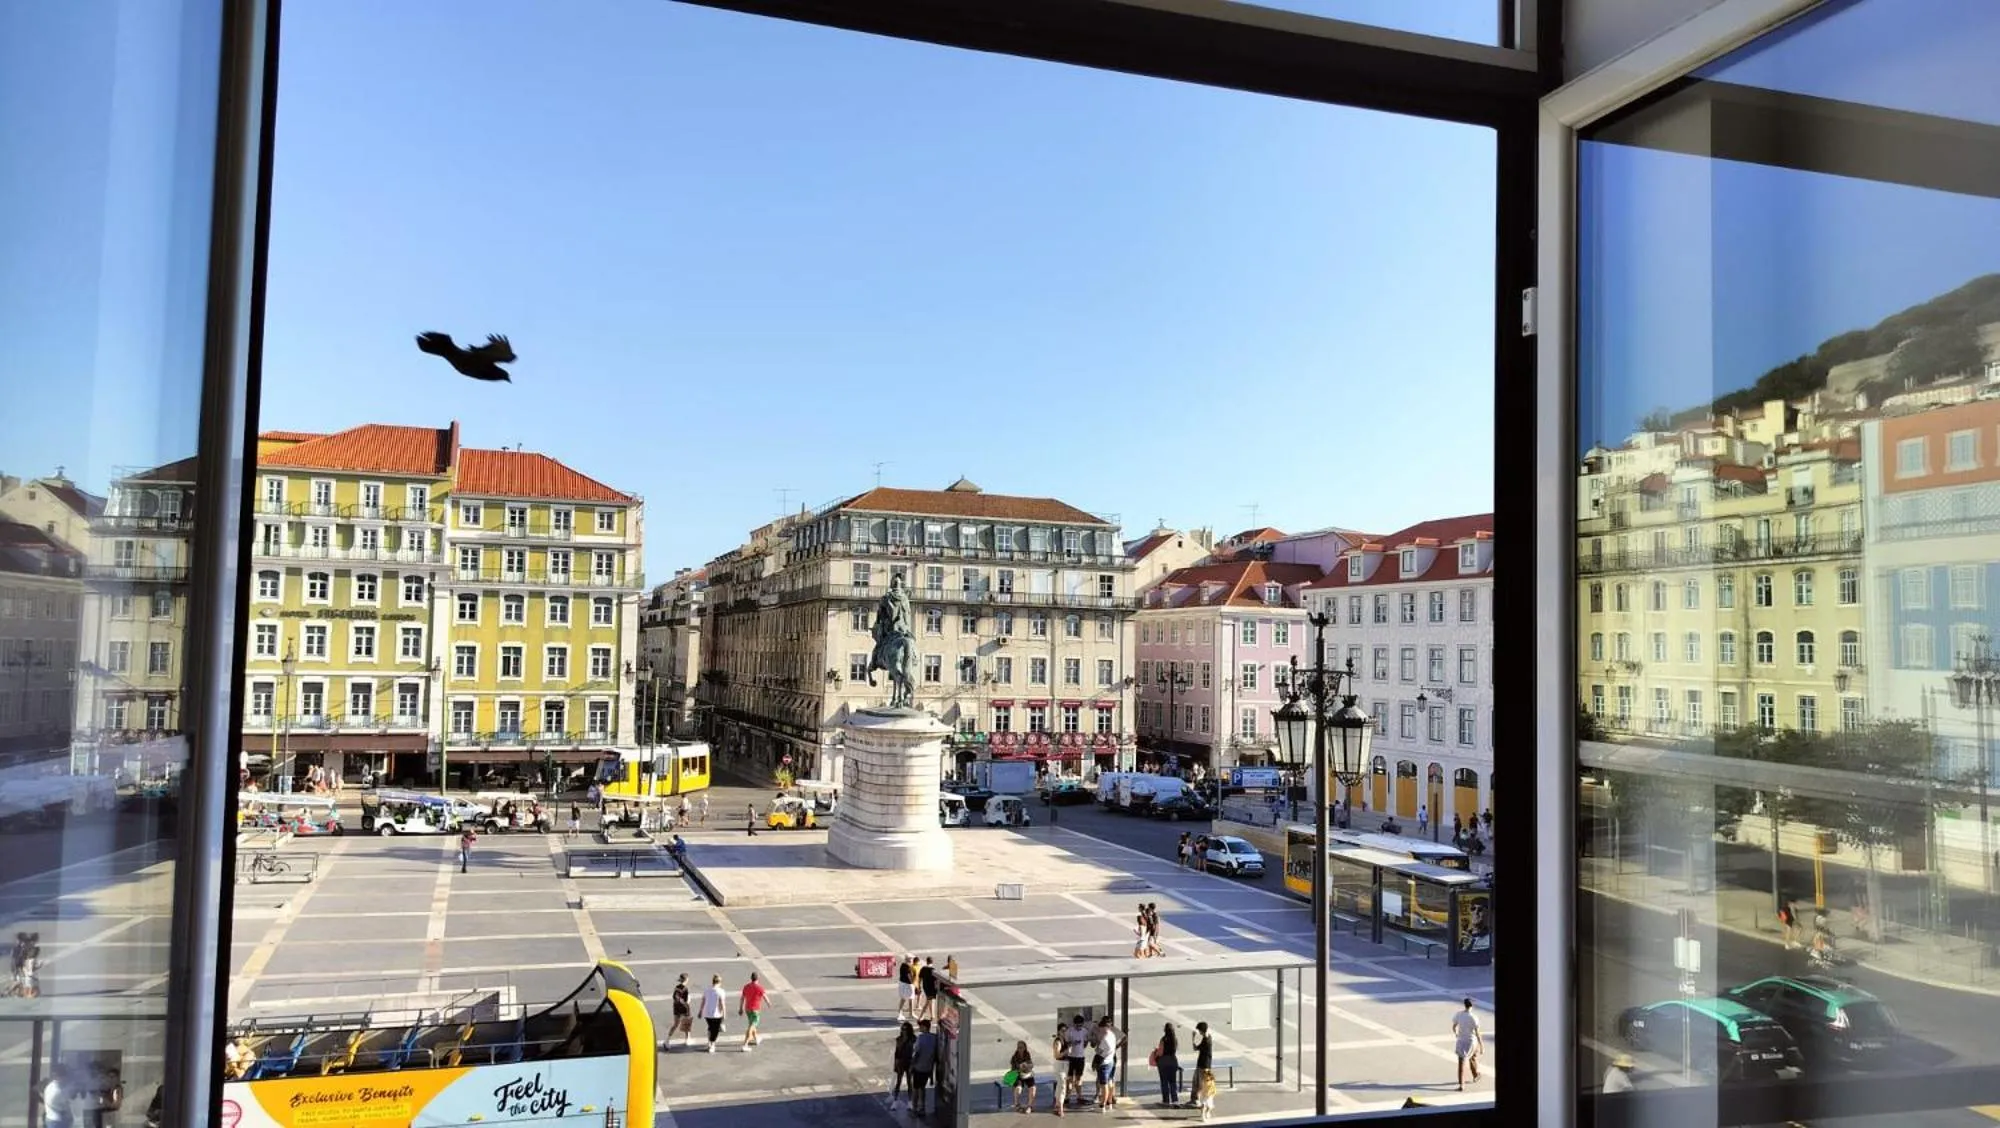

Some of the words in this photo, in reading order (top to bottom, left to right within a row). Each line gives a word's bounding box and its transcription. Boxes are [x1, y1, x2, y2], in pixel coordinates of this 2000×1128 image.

[289, 1091, 355, 1109] Exclusive
[358, 1085, 415, 1106] Benefits
[494, 1072, 543, 1112] Feel
[508, 1102, 527, 1117] the
[530, 1087, 573, 1118] city
